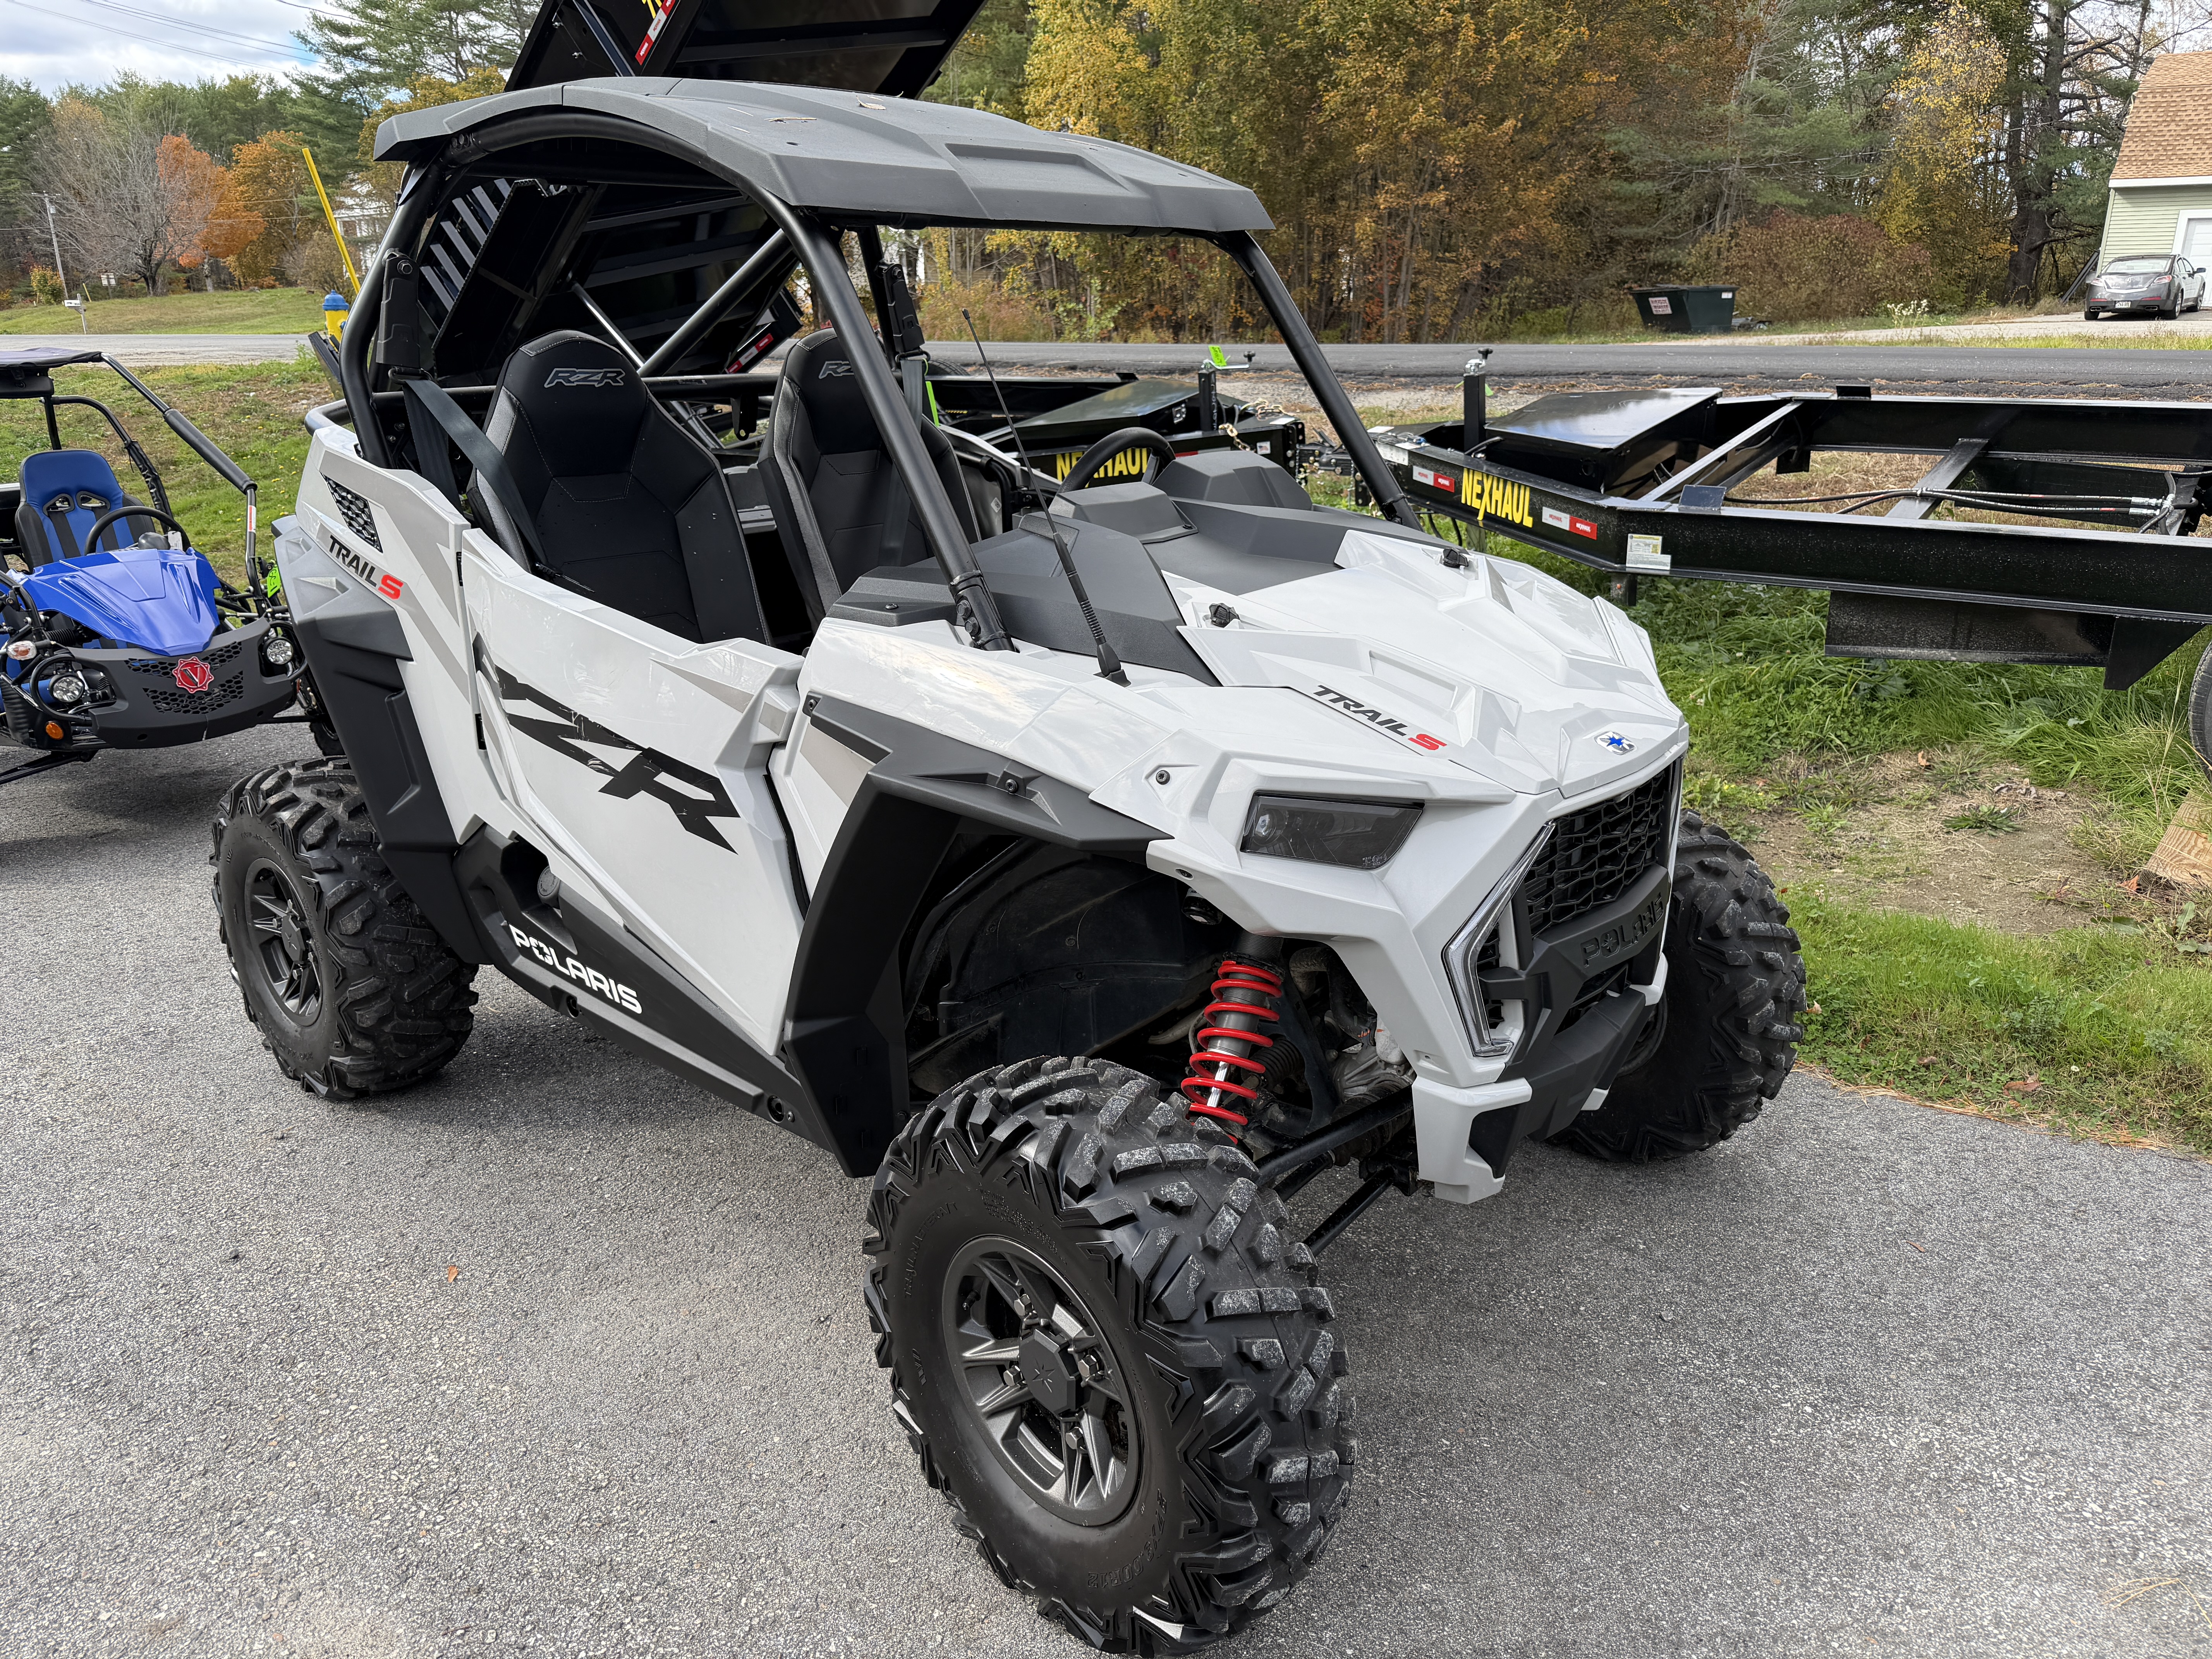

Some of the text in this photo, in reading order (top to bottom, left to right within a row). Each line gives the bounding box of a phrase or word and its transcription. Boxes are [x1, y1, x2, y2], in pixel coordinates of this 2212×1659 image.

[544, 368, 625, 388] RZR
[818, 361, 854, 379] RZ
[1461, 467, 1533, 527] NEXHAUL
[329, 534, 404, 599] TRAIL S
[1313, 685, 1447, 750] TRAIL S
[1580, 892, 1664, 968] POLARIS
[509, 924, 642, 1014] POLARIS
